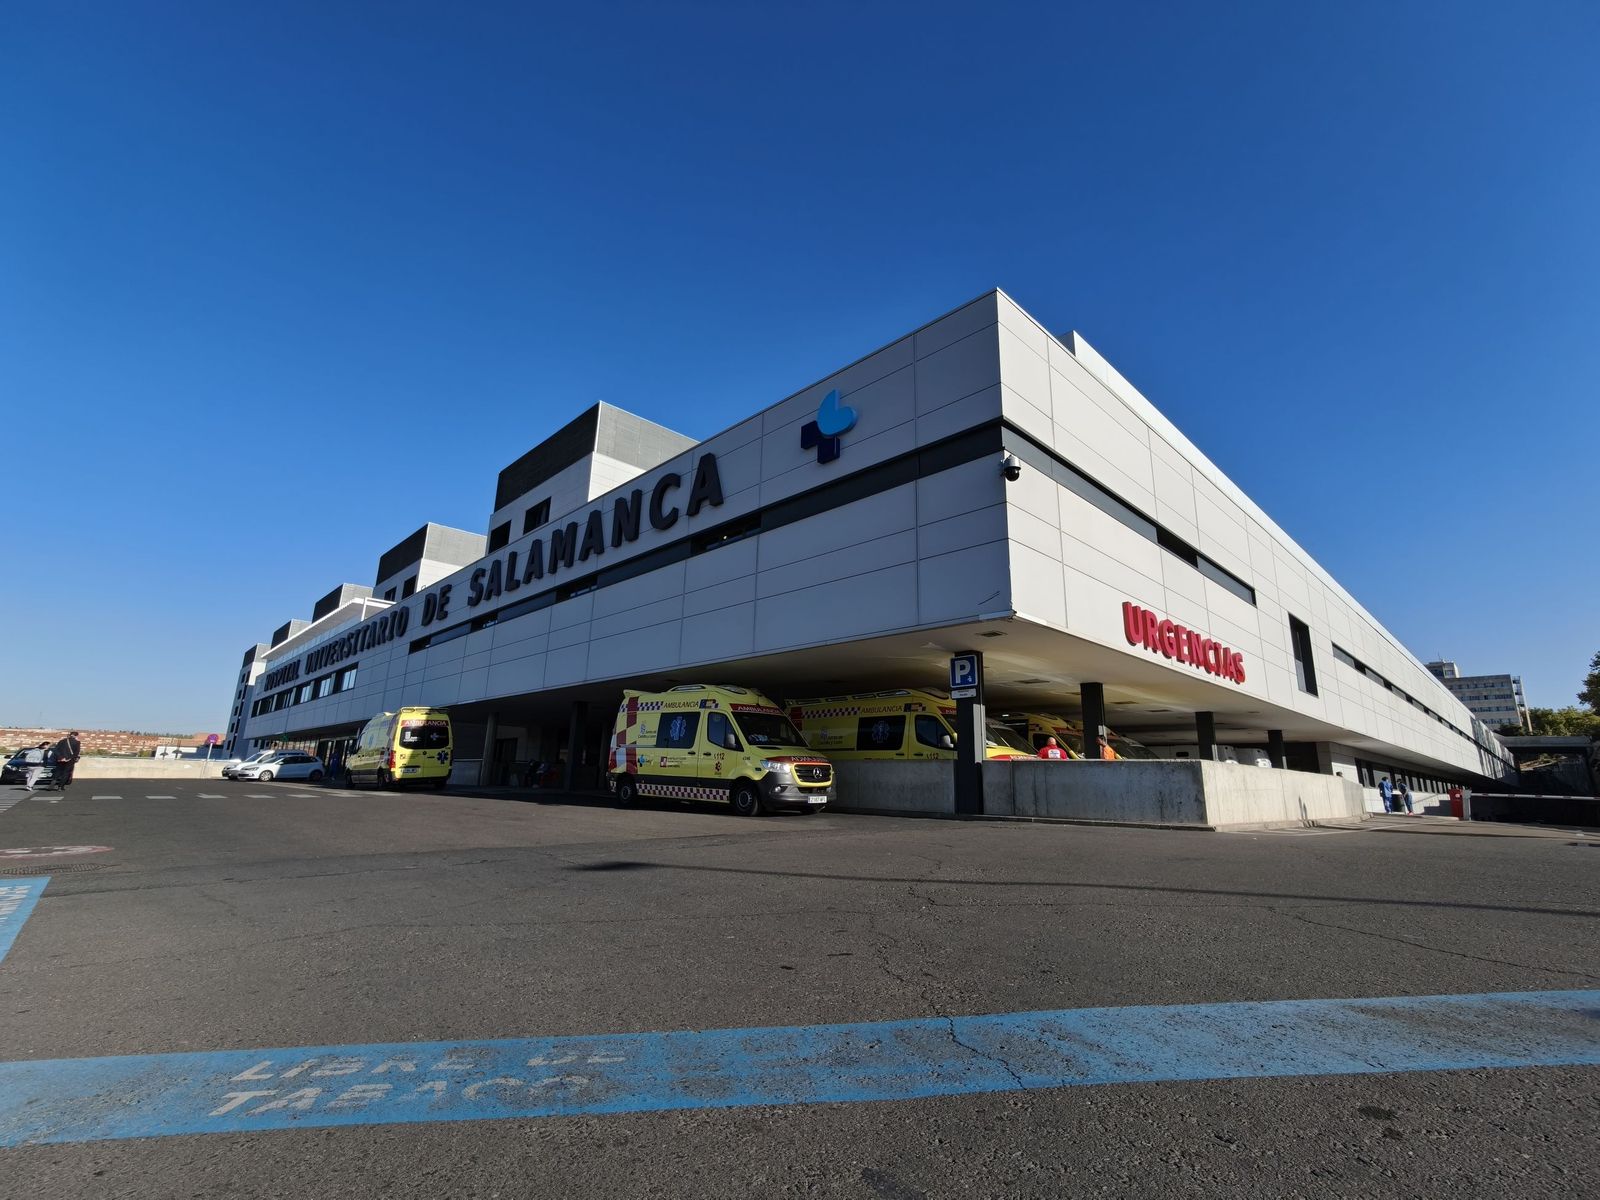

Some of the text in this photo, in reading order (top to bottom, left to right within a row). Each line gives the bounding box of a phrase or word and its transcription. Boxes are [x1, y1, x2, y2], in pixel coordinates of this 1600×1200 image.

[265, 453, 723, 691] HOSPITAL UNIVERSITARIO DE SALAMANCA
[1122, 601, 1245, 684] URGENCIAS
[955, 660, 971, 683] P
[664, 701, 699, 709] AMBULANCIA
[862, 705, 902, 714] AMBULANCIA
[230, 1048, 497, 1082] LIBRE
